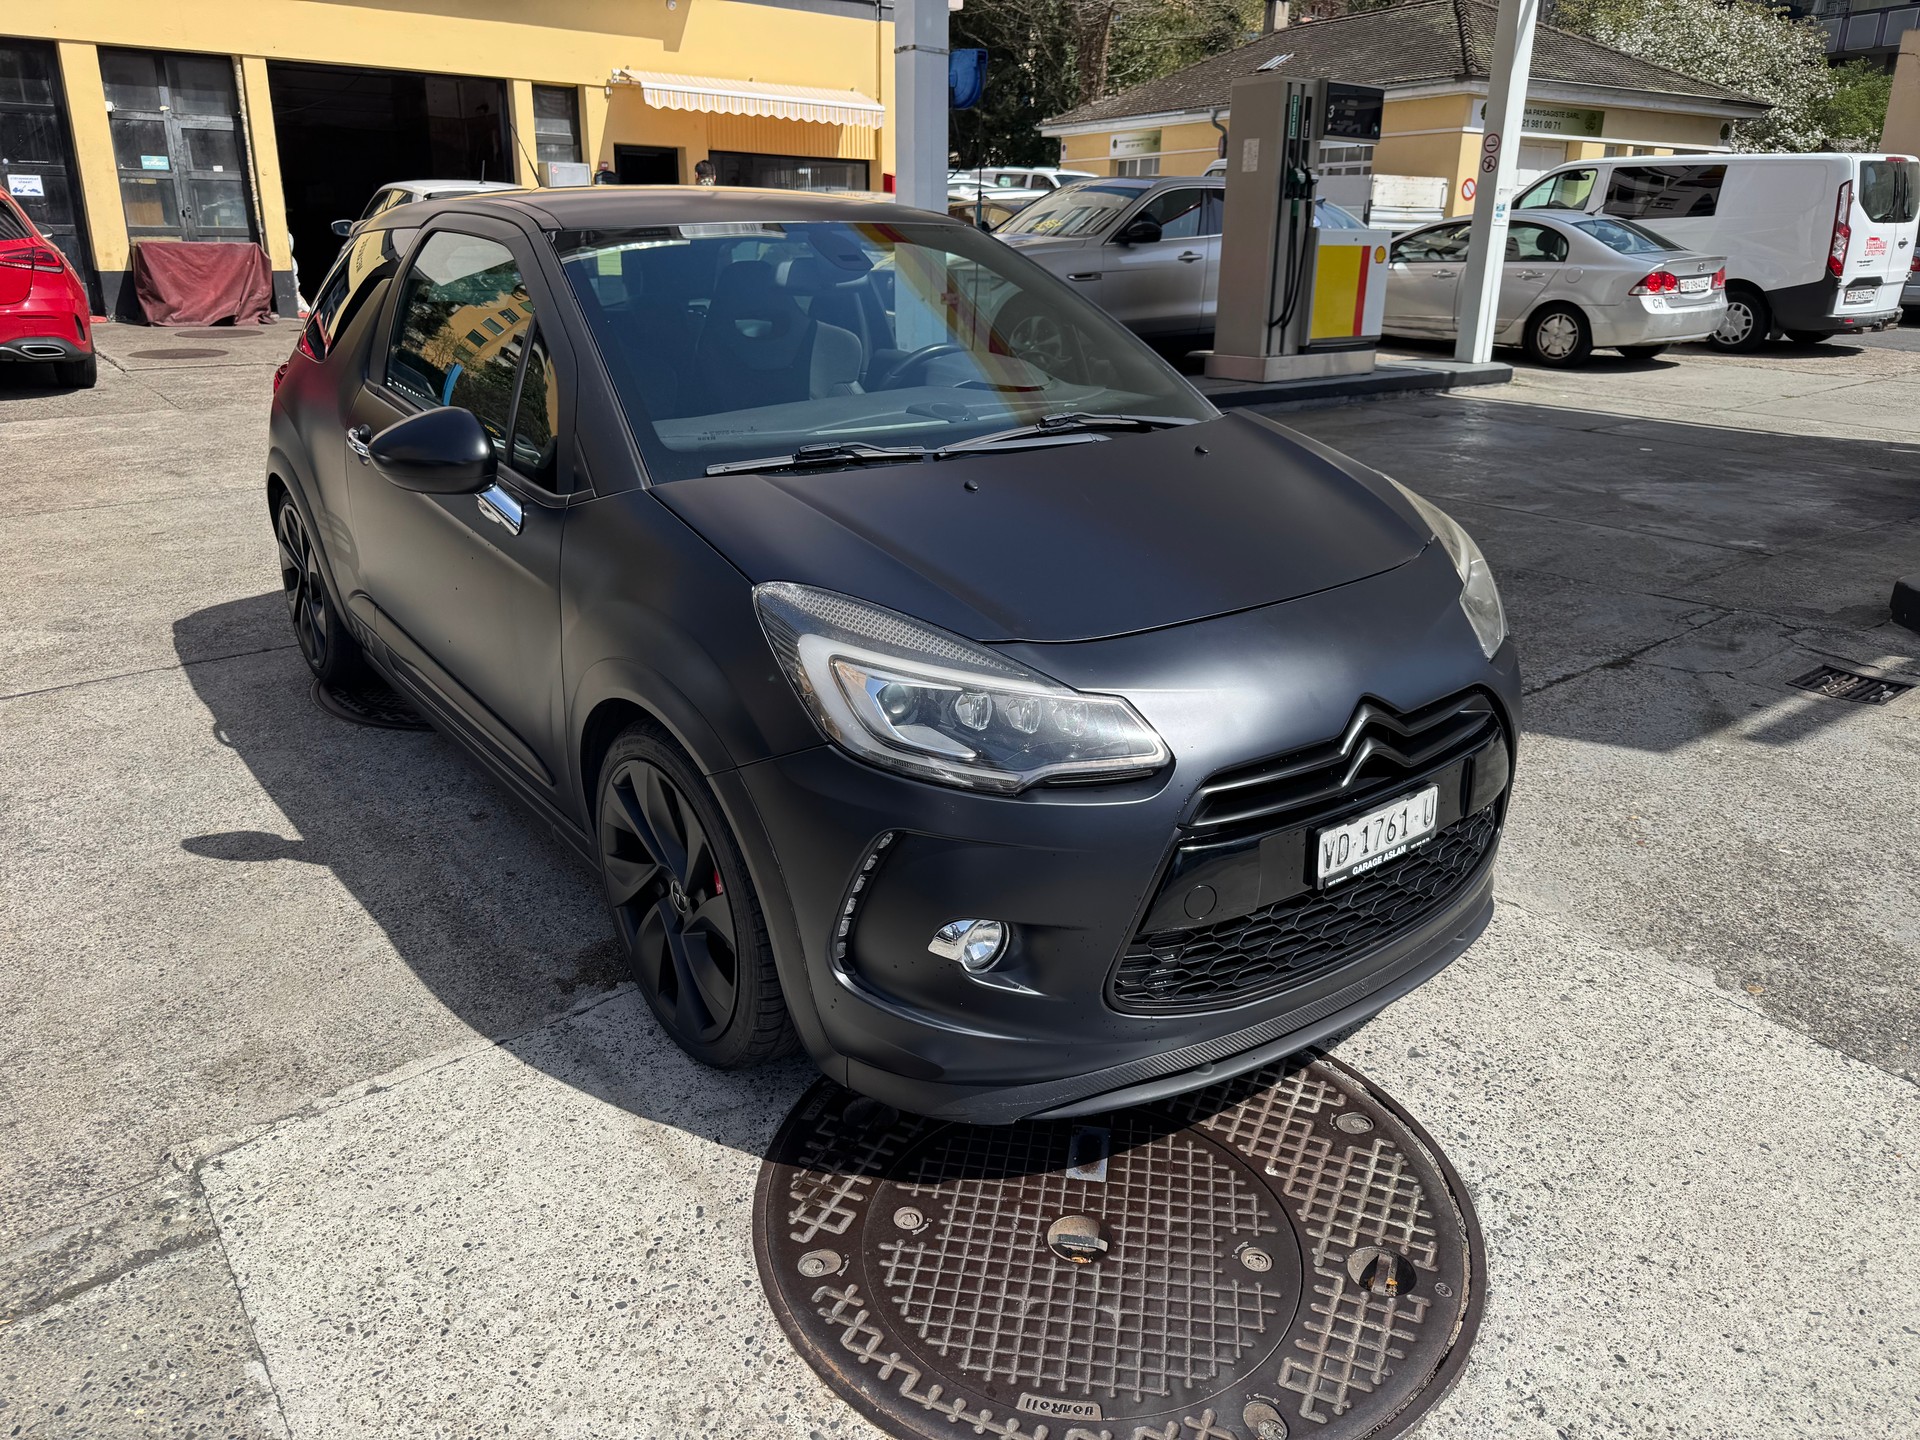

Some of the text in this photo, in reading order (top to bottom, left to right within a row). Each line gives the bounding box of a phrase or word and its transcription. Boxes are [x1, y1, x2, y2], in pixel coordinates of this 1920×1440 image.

[1327, 105, 1336, 118] 3
[1533, 109, 1565, 119] PAYSAGISTE
[1565, 111, 1580, 120] SARL
[1543, 120, 1553, 129] 00
[1553, 121, 1561, 130] 71
[1652, 298, 1664, 309] CH
[1360, 806, 1409, 856] 1761
[1423, 791, 1436, 828] U
[1352, 844, 1407, 875] GARAGE ASLAN
